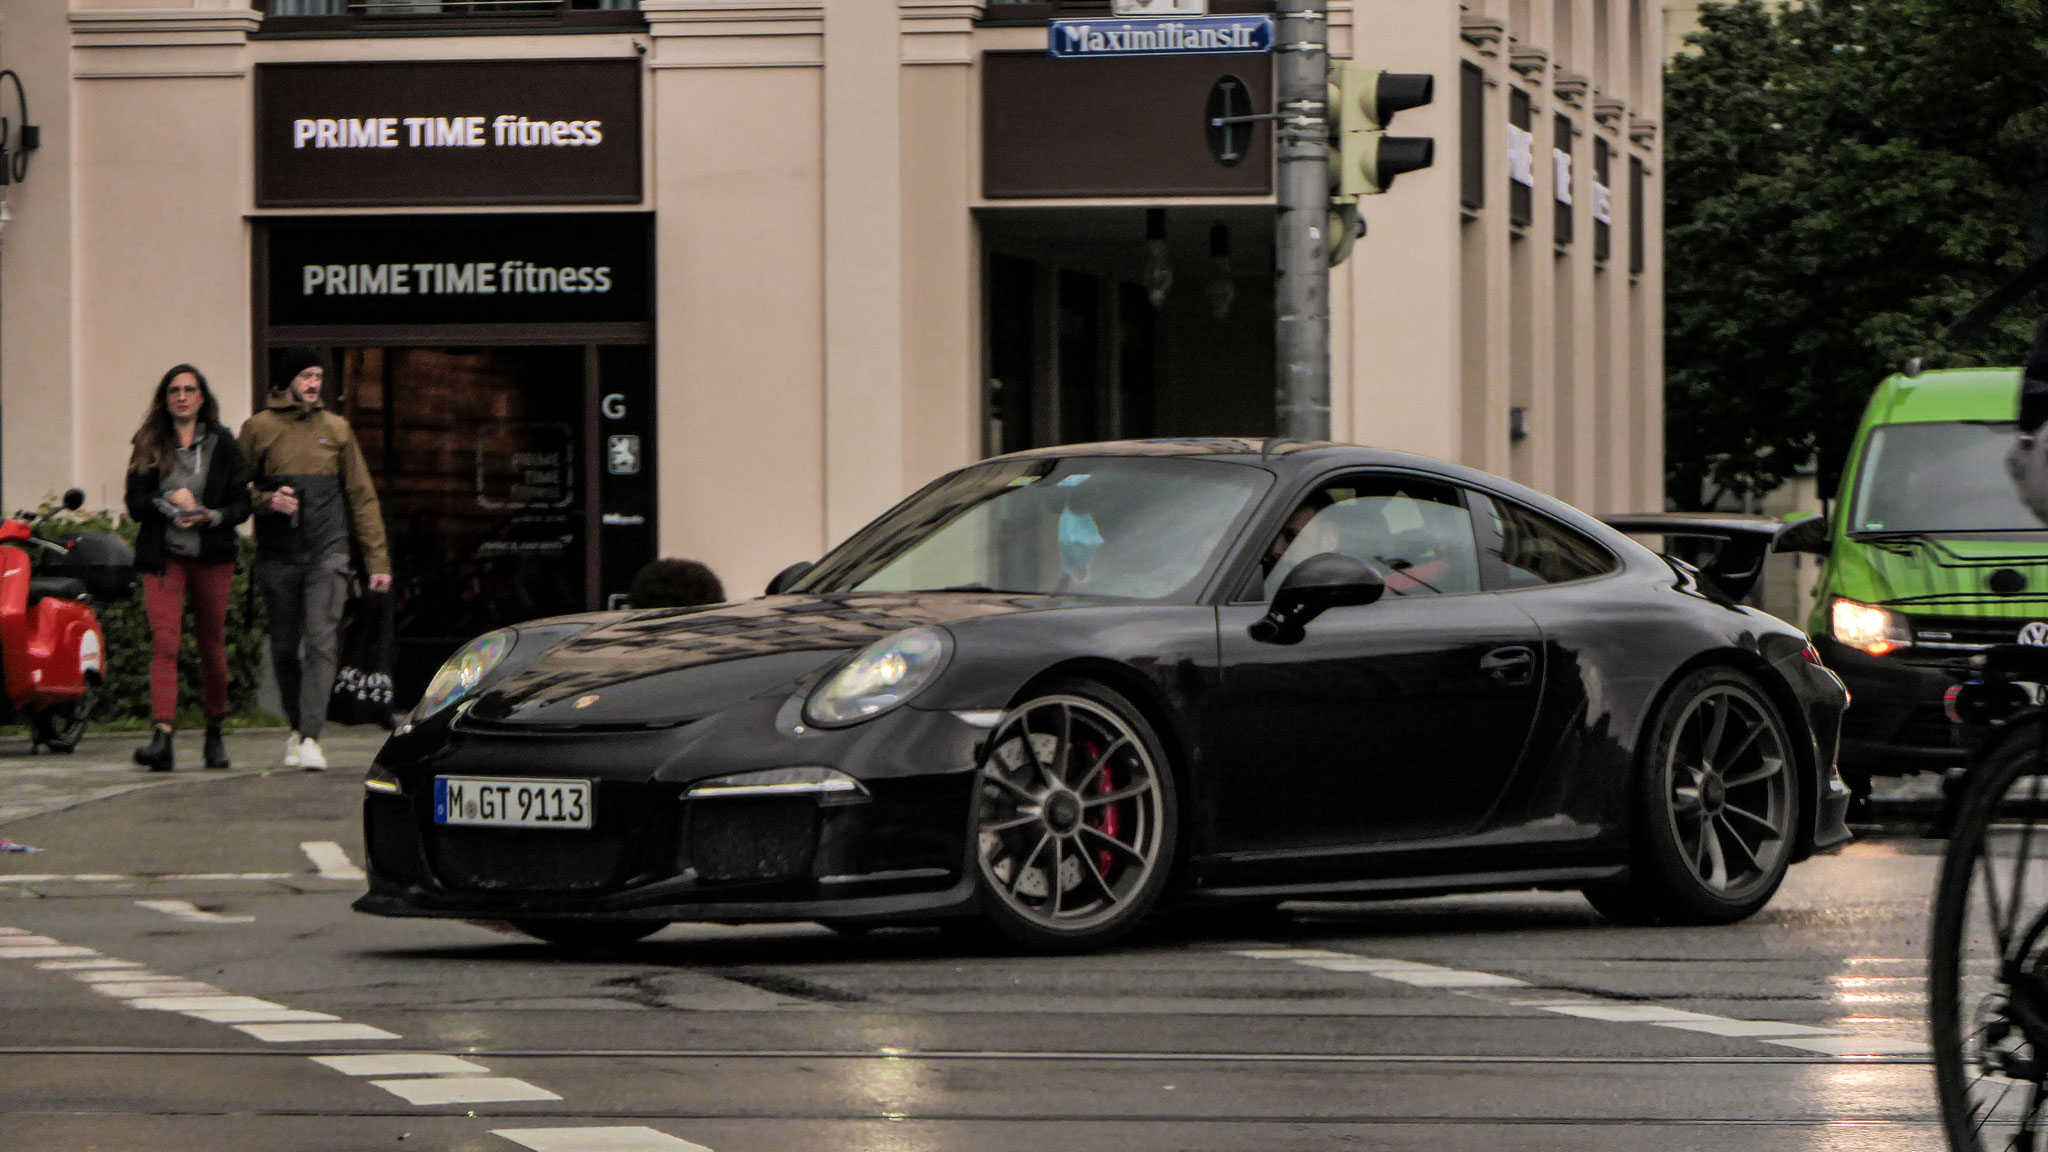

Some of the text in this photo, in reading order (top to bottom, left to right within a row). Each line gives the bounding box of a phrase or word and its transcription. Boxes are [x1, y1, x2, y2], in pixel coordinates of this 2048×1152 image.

[1063, 22, 1260, 52] Maximilianstr.
[294, 114, 603, 149] PRIME TIME fitness
[303, 261, 613, 295] PRIME TIME fitness
[601, 393, 627, 420] G
[448, 784, 584, 822] M GT 9113
